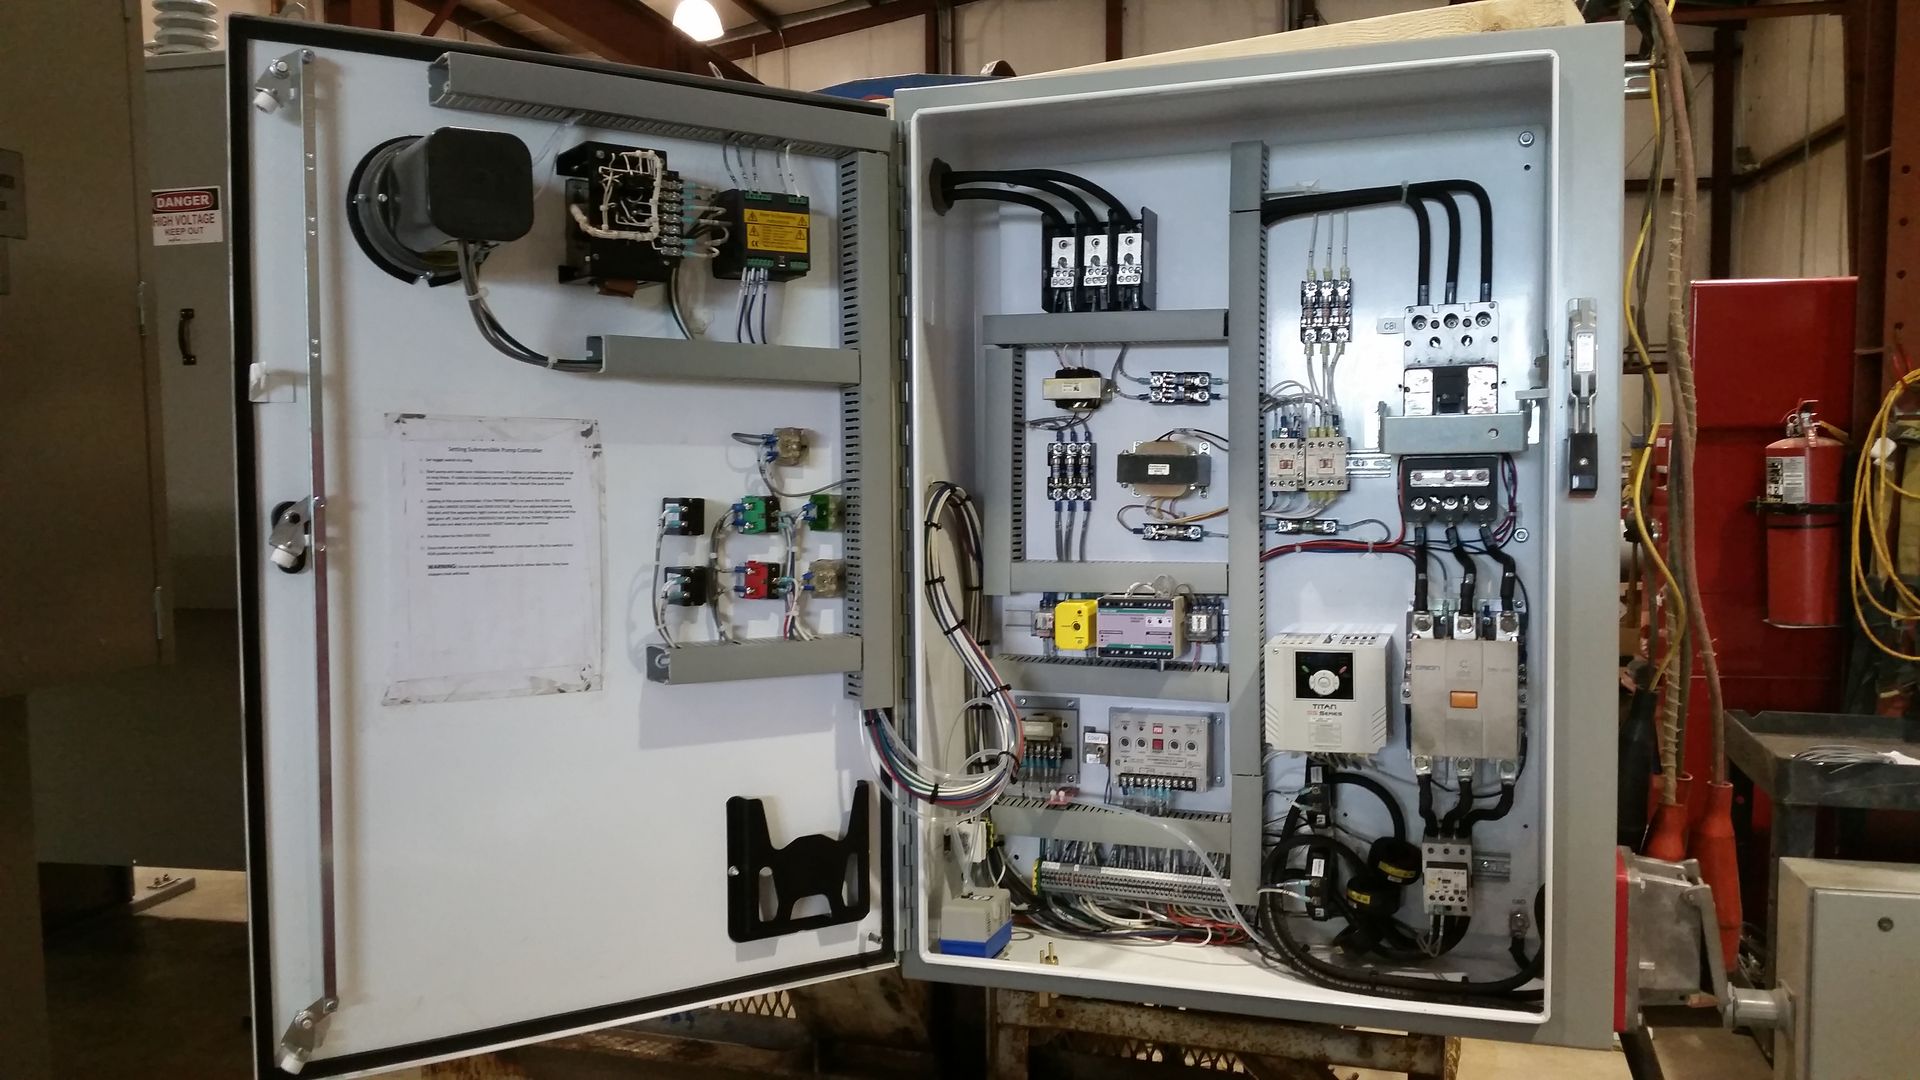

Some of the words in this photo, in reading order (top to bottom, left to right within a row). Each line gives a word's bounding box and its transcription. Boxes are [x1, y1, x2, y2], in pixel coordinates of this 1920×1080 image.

[156, 195, 210, 208] DANGER
[153, 215, 173, 227] HIGH
[175, 213, 215, 226] VOLTAGE
[165, 227, 187, 236] KEEP
[188, 226, 204, 235] OUT
